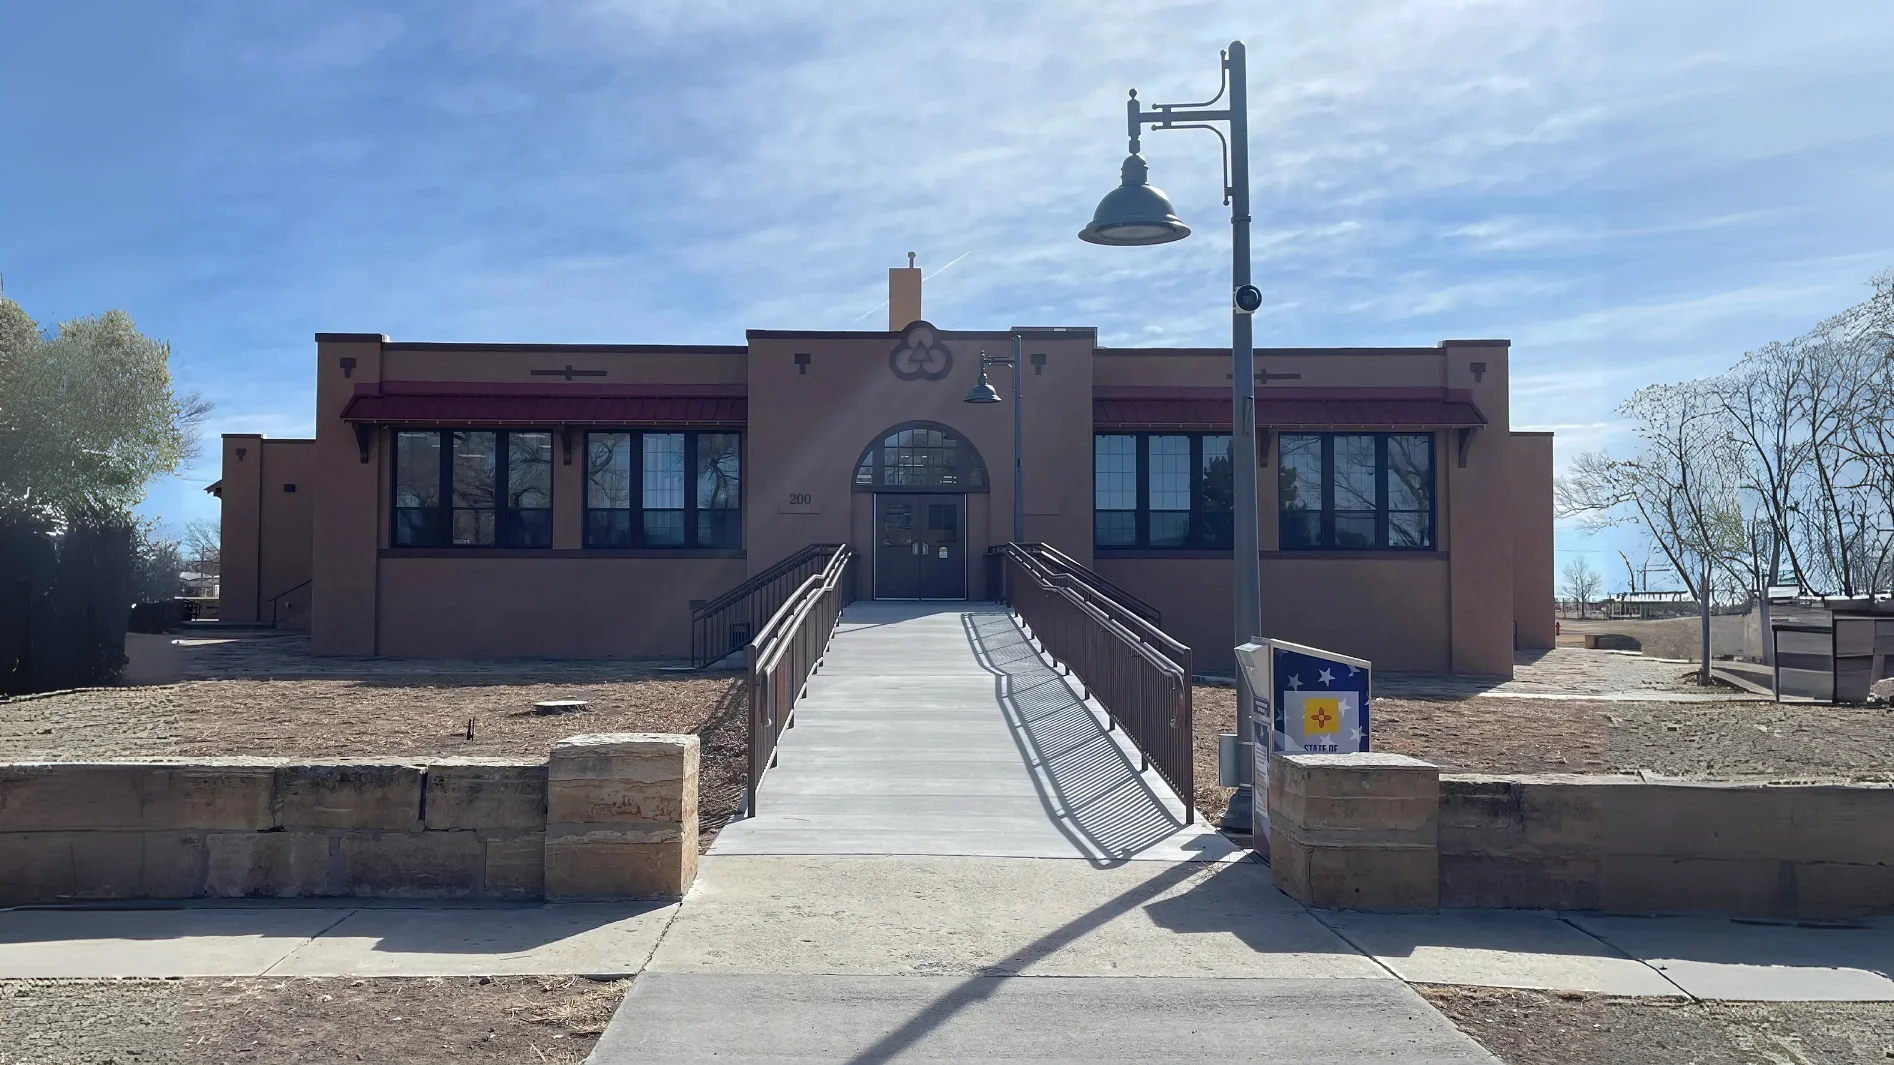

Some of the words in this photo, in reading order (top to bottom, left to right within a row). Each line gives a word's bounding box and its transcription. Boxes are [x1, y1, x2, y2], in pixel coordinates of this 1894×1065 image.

[789, 493, 811, 504] 200
[1304, 744, 1327, 752] STATE
[1328, 744, 1338, 752] OF
